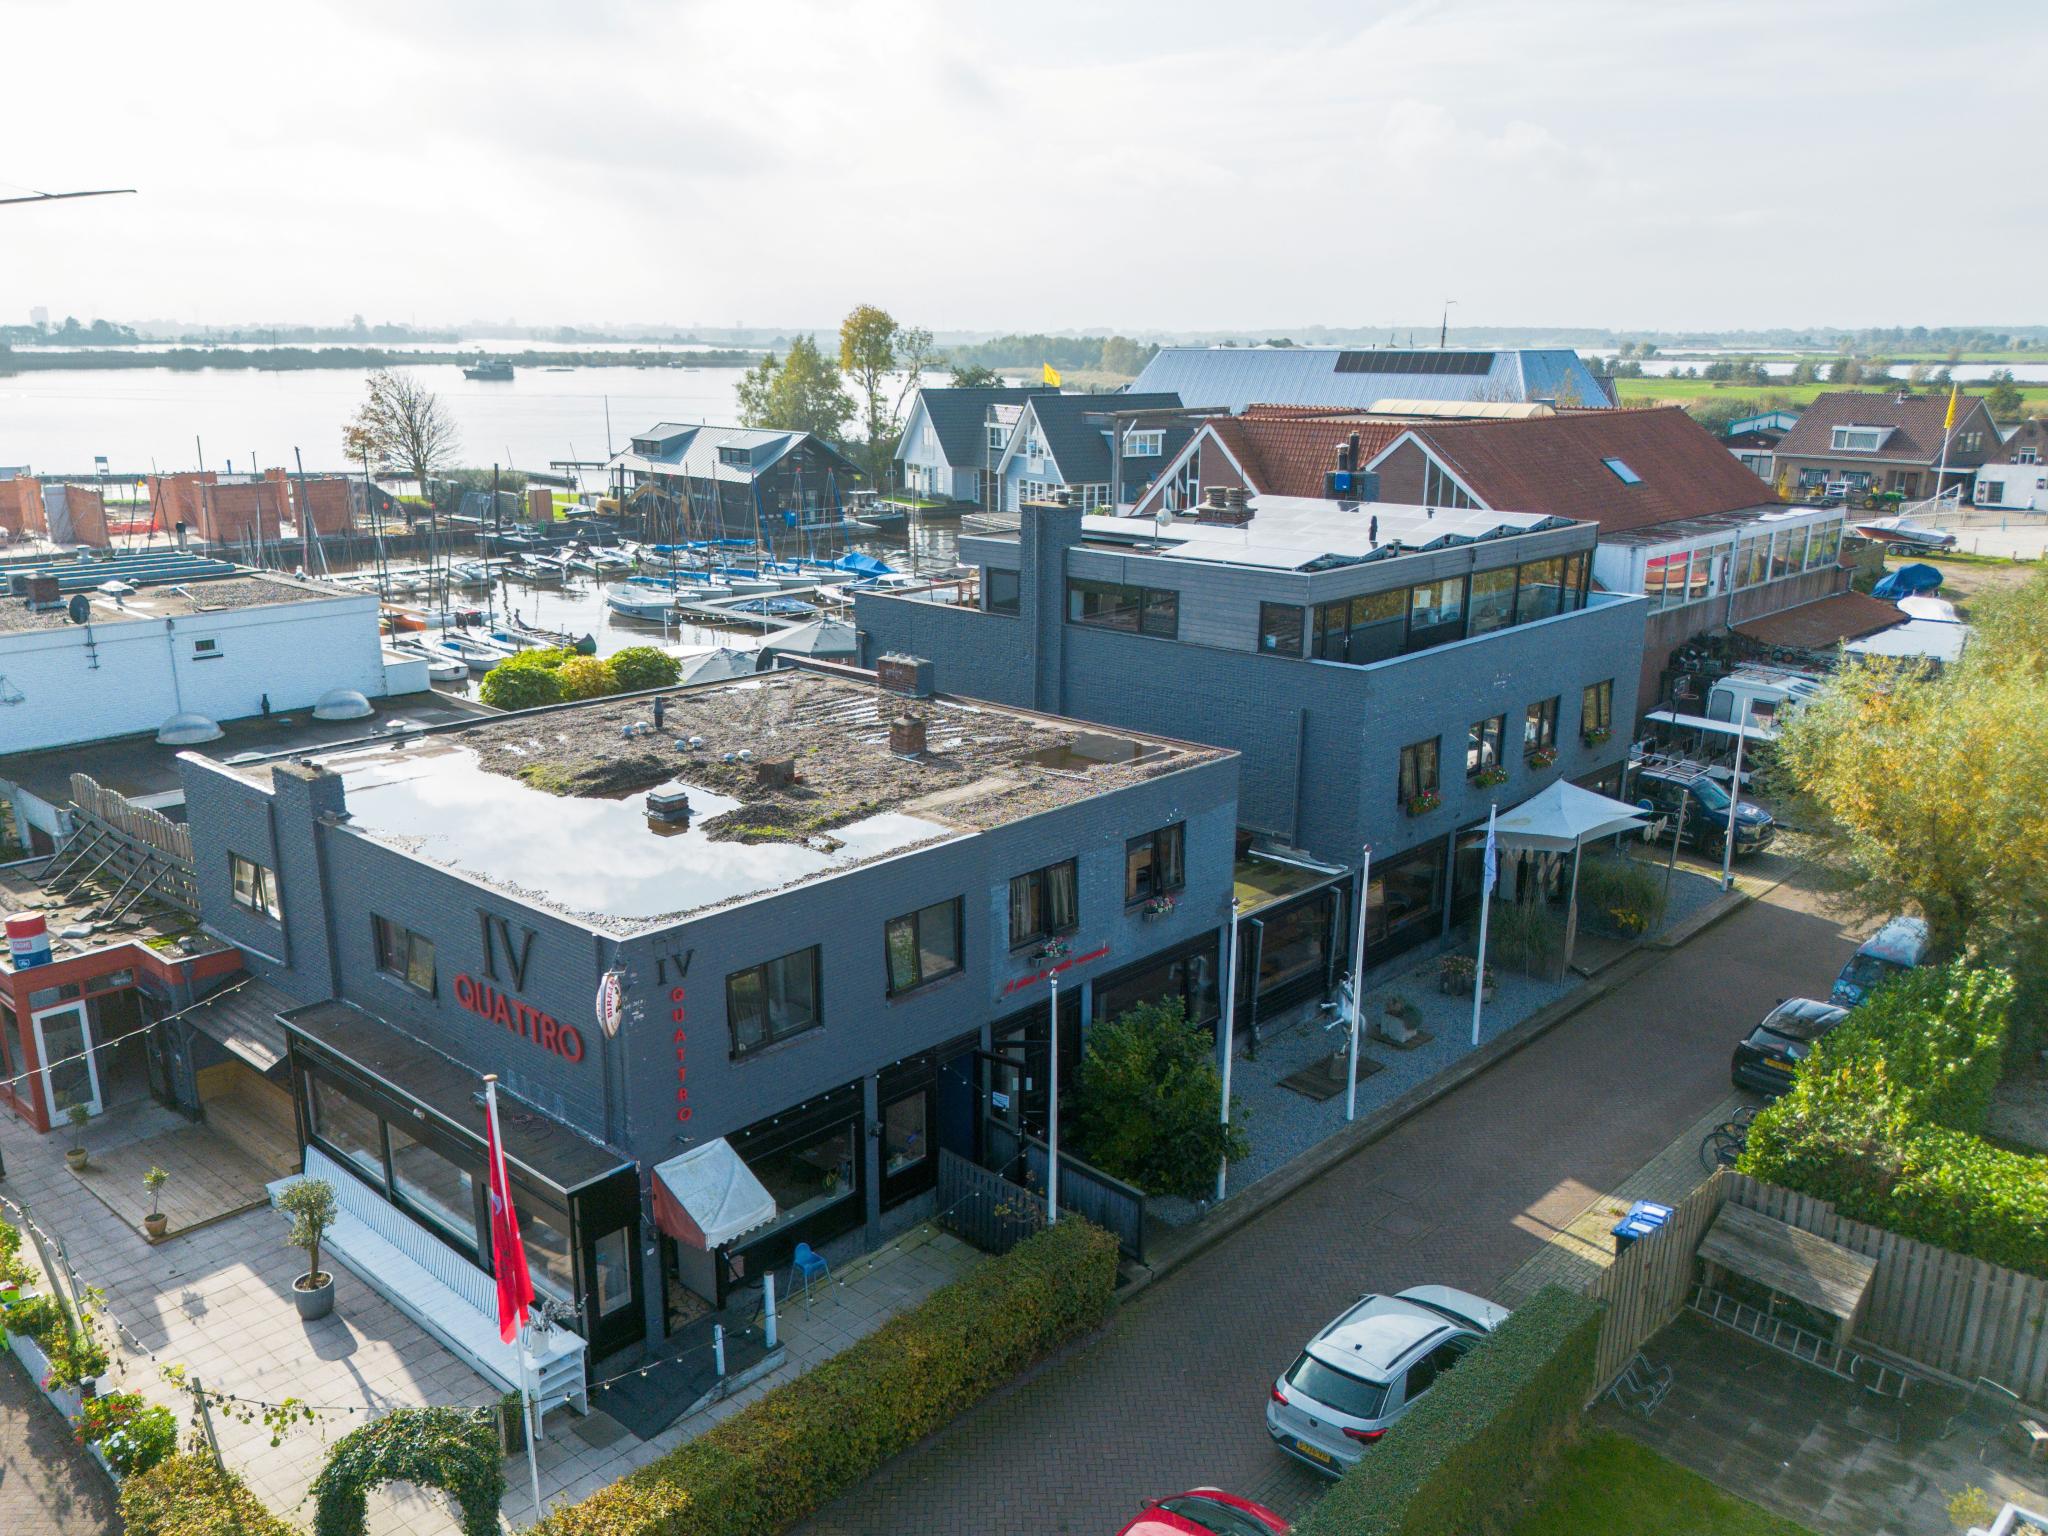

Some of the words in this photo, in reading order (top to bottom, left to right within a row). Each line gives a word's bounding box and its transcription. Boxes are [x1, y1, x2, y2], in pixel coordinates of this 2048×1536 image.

[476, 908, 537, 992] IV
[656, 949, 695, 986] IV
[454, 973, 585, 1063] QUATTRO
[672, 987, 692, 1121] QUATTRO
